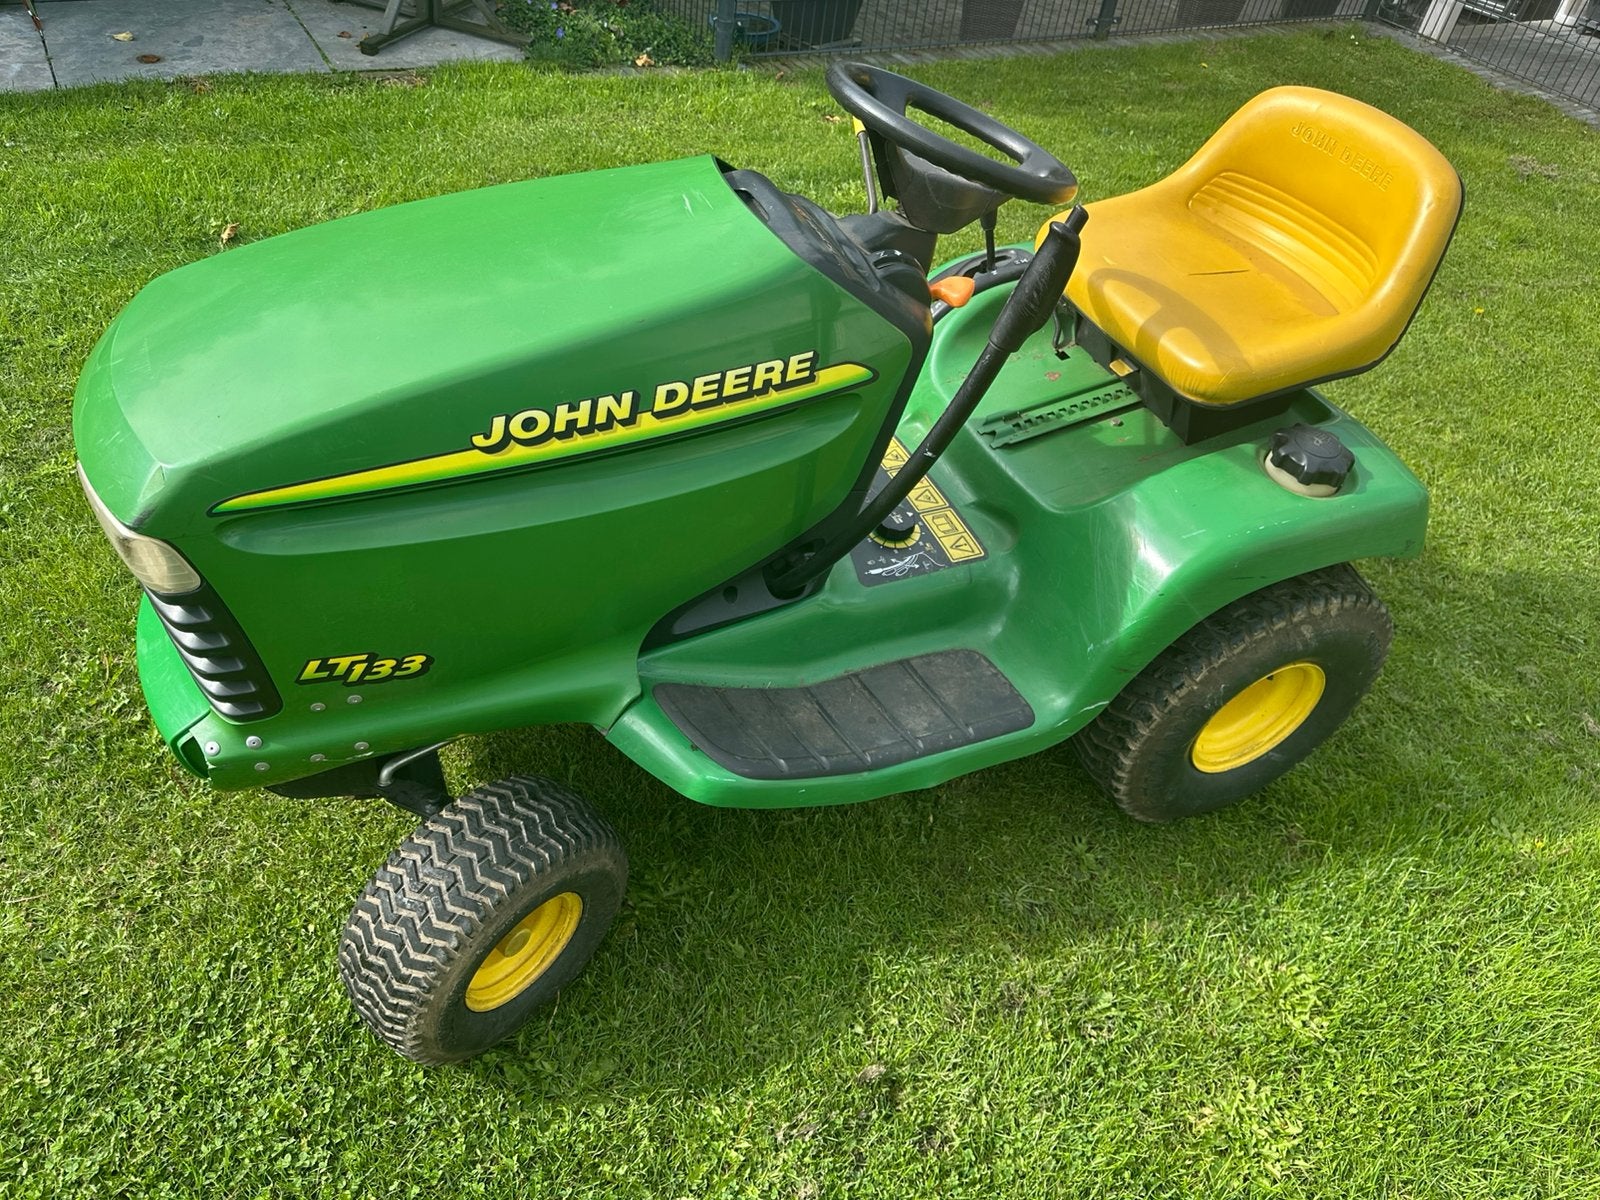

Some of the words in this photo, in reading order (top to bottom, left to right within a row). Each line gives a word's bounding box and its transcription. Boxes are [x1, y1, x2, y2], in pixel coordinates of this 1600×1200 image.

[1291, 121, 1338, 157] JOHN
[1339, 146, 1393, 192] DEERE
[471, 390, 637, 451] JOHN
[652, 350, 817, 415] DEERE
